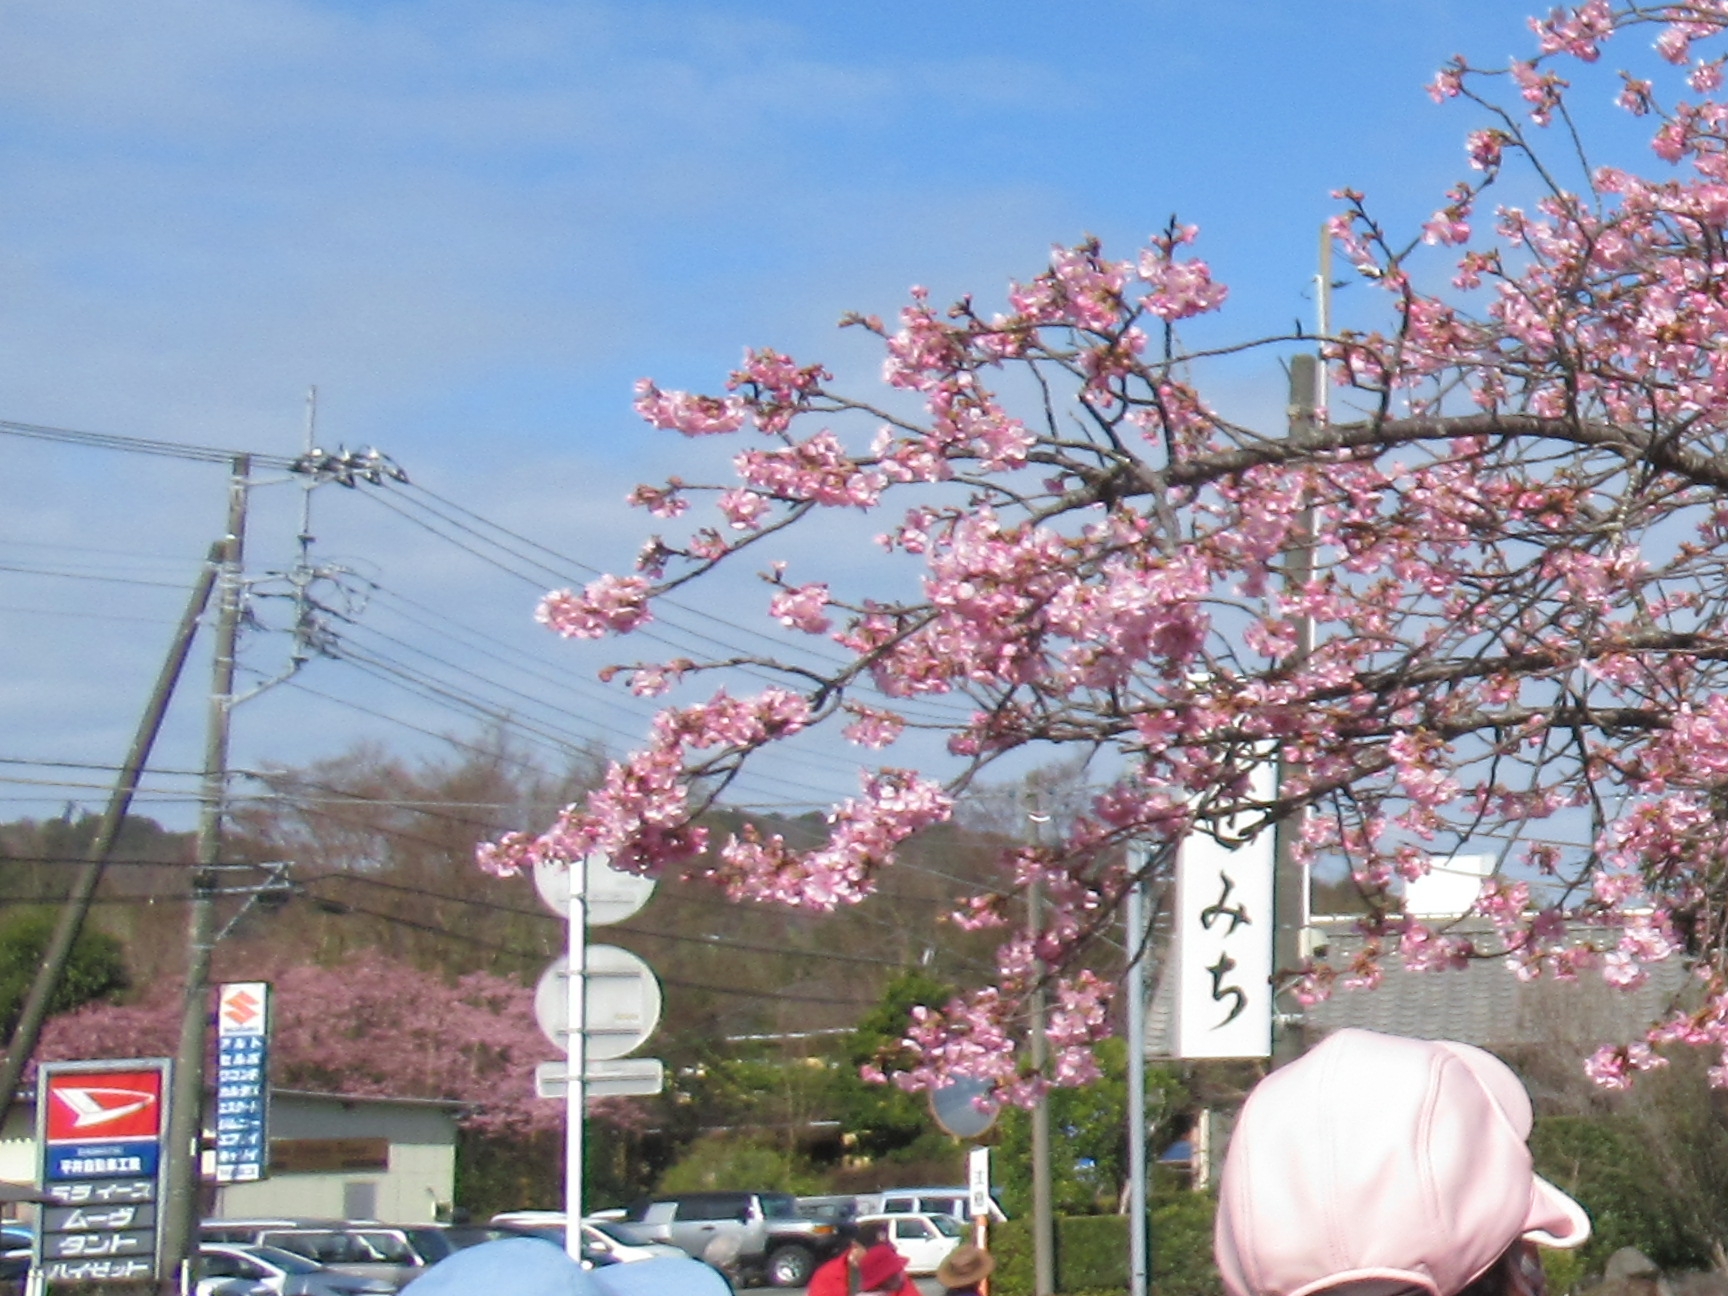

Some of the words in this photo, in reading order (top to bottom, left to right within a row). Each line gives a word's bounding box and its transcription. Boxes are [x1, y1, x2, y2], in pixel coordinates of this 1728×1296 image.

[62, 1207, 135, 1229] ムーヴ
[59, 1234, 137, 1256] タント
